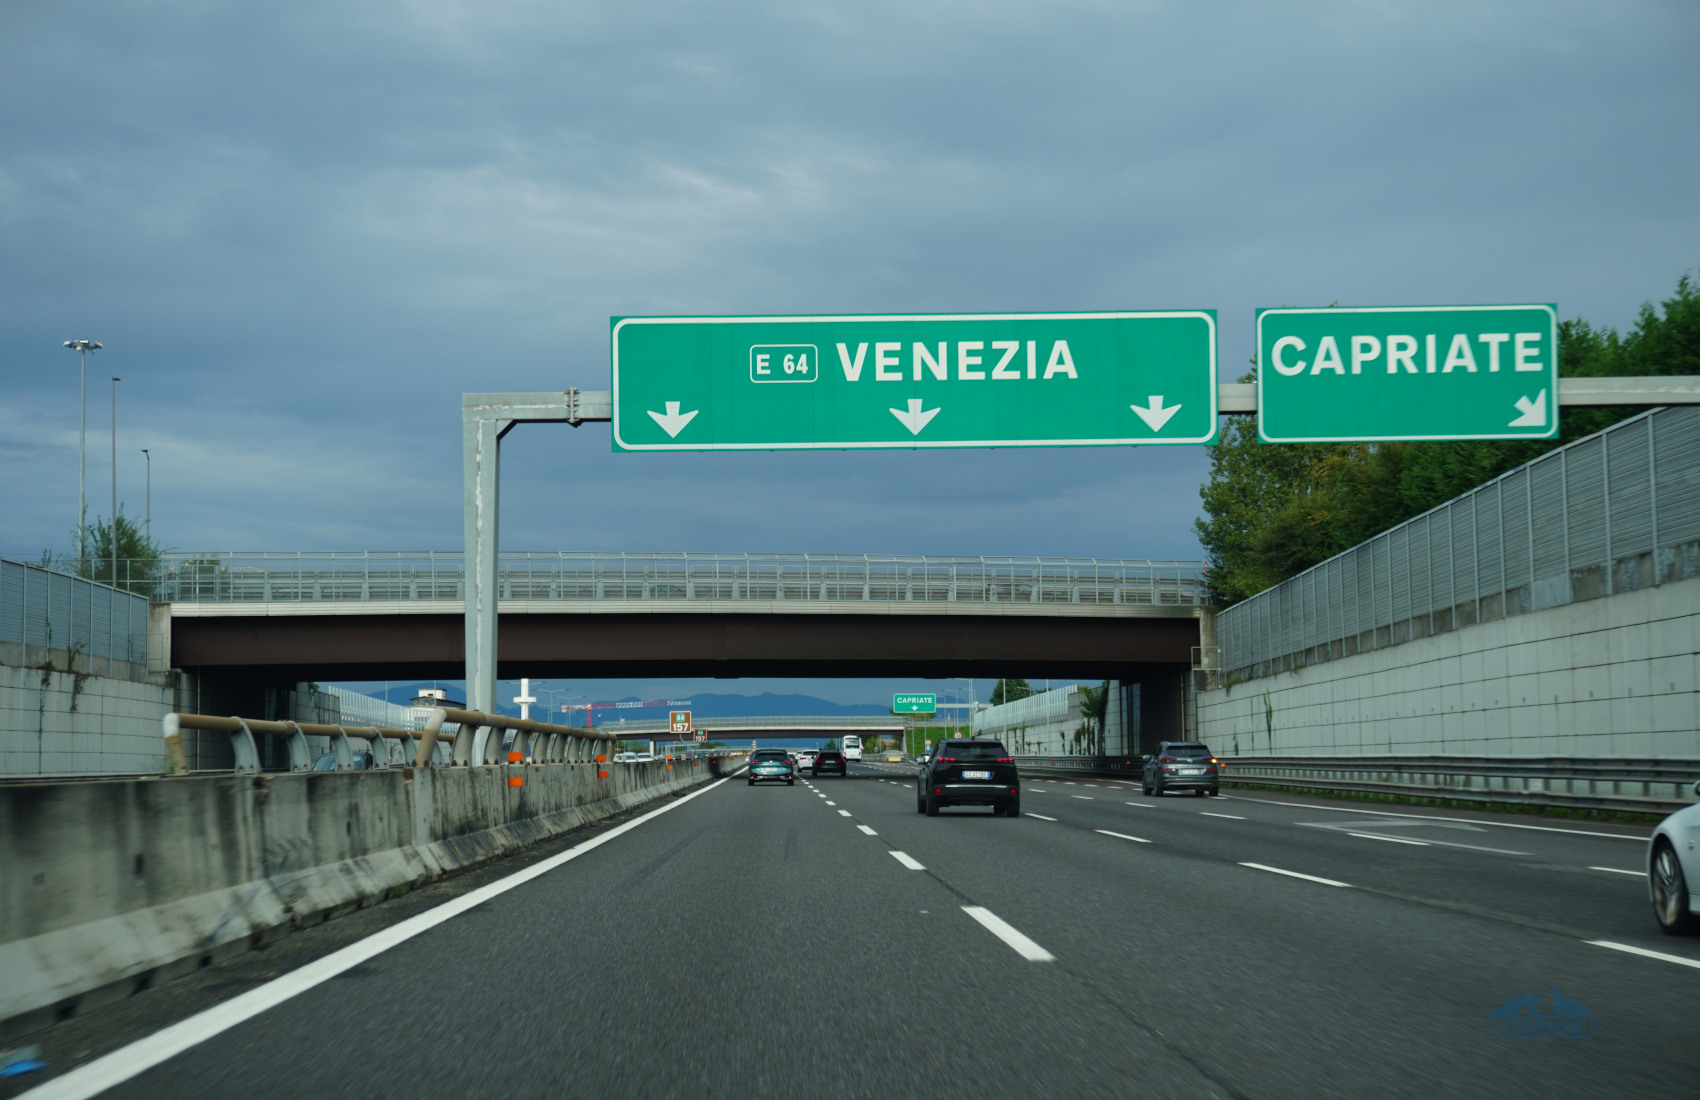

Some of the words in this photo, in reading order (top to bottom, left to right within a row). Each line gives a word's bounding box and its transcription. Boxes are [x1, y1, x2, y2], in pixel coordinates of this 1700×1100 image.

[756, 354, 771, 375] E
[782, 353, 809, 375] 64
[835, 340, 1078, 382] VENEZIA
[1271, 332, 1543, 376] CAPRIATE
[673, 723, 688, 732] 157
